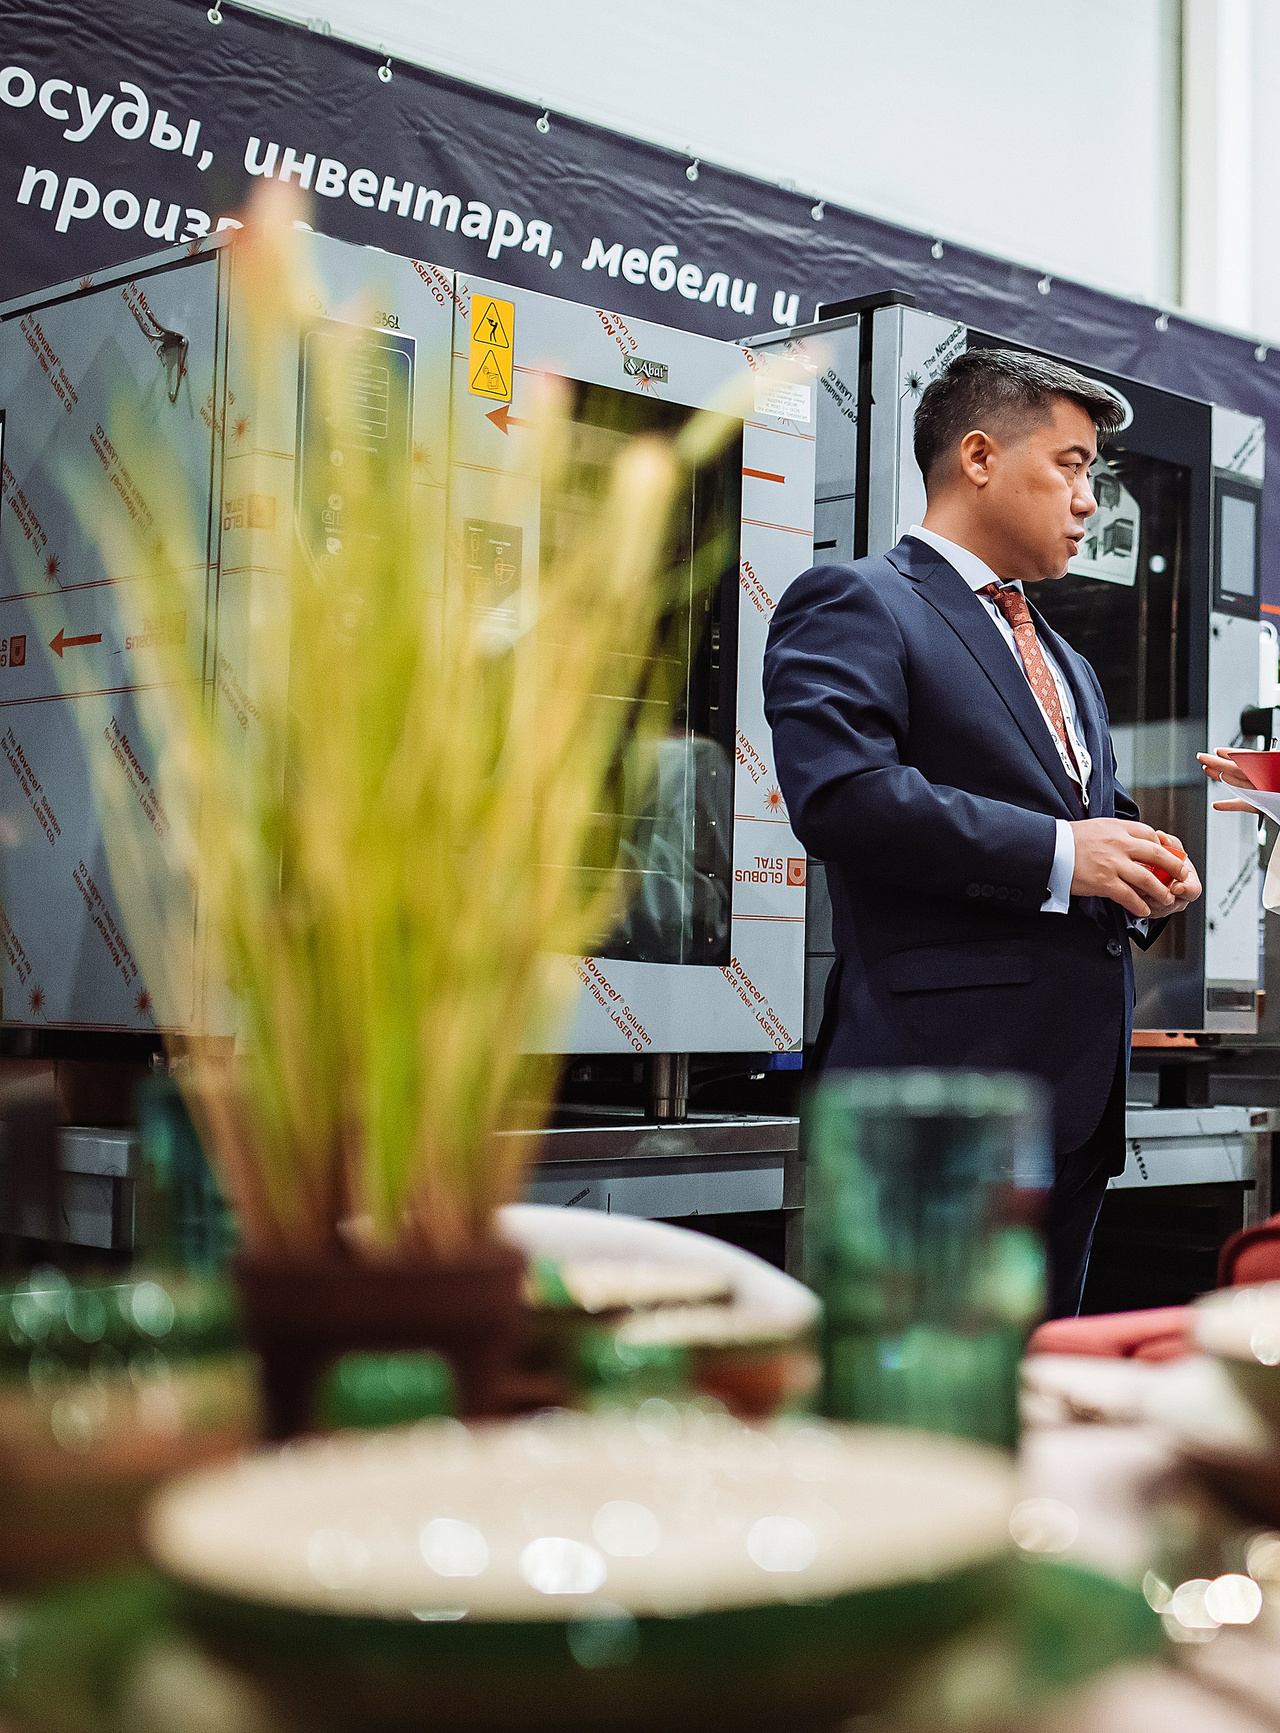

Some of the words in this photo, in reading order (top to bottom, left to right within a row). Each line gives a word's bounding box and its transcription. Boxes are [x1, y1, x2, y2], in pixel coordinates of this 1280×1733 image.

[0, 65, 214, 171] осуды,
[243, 136, 562, 270] инвентаря,
[582, 236, 759, 315] мебели
[773, 289, 800, 327] и
[410, 260, 433, 287] ASER
[627, 336, 639, 351] for
[748, 590, 765, 613] Fiber
[738, 733, 760, 763] LASER
[747, 763, 761, 785] The
[757, 761, 769, 776] for
[753, 855, 784, 870] STAL
[734, 869, 783, 885] GLOBUS
[588, 983, 608, 1007] Fiber
[610, 1011, 633, 1040] LASER
[718, 966, 738, 989] ASER
[736, 986, 753, 1008] Fiber
[755, 1011, 776, 1040] LASER
[621, 1006, 652, 1046] Solution
[765, 1007, 793, 1045] Solution
